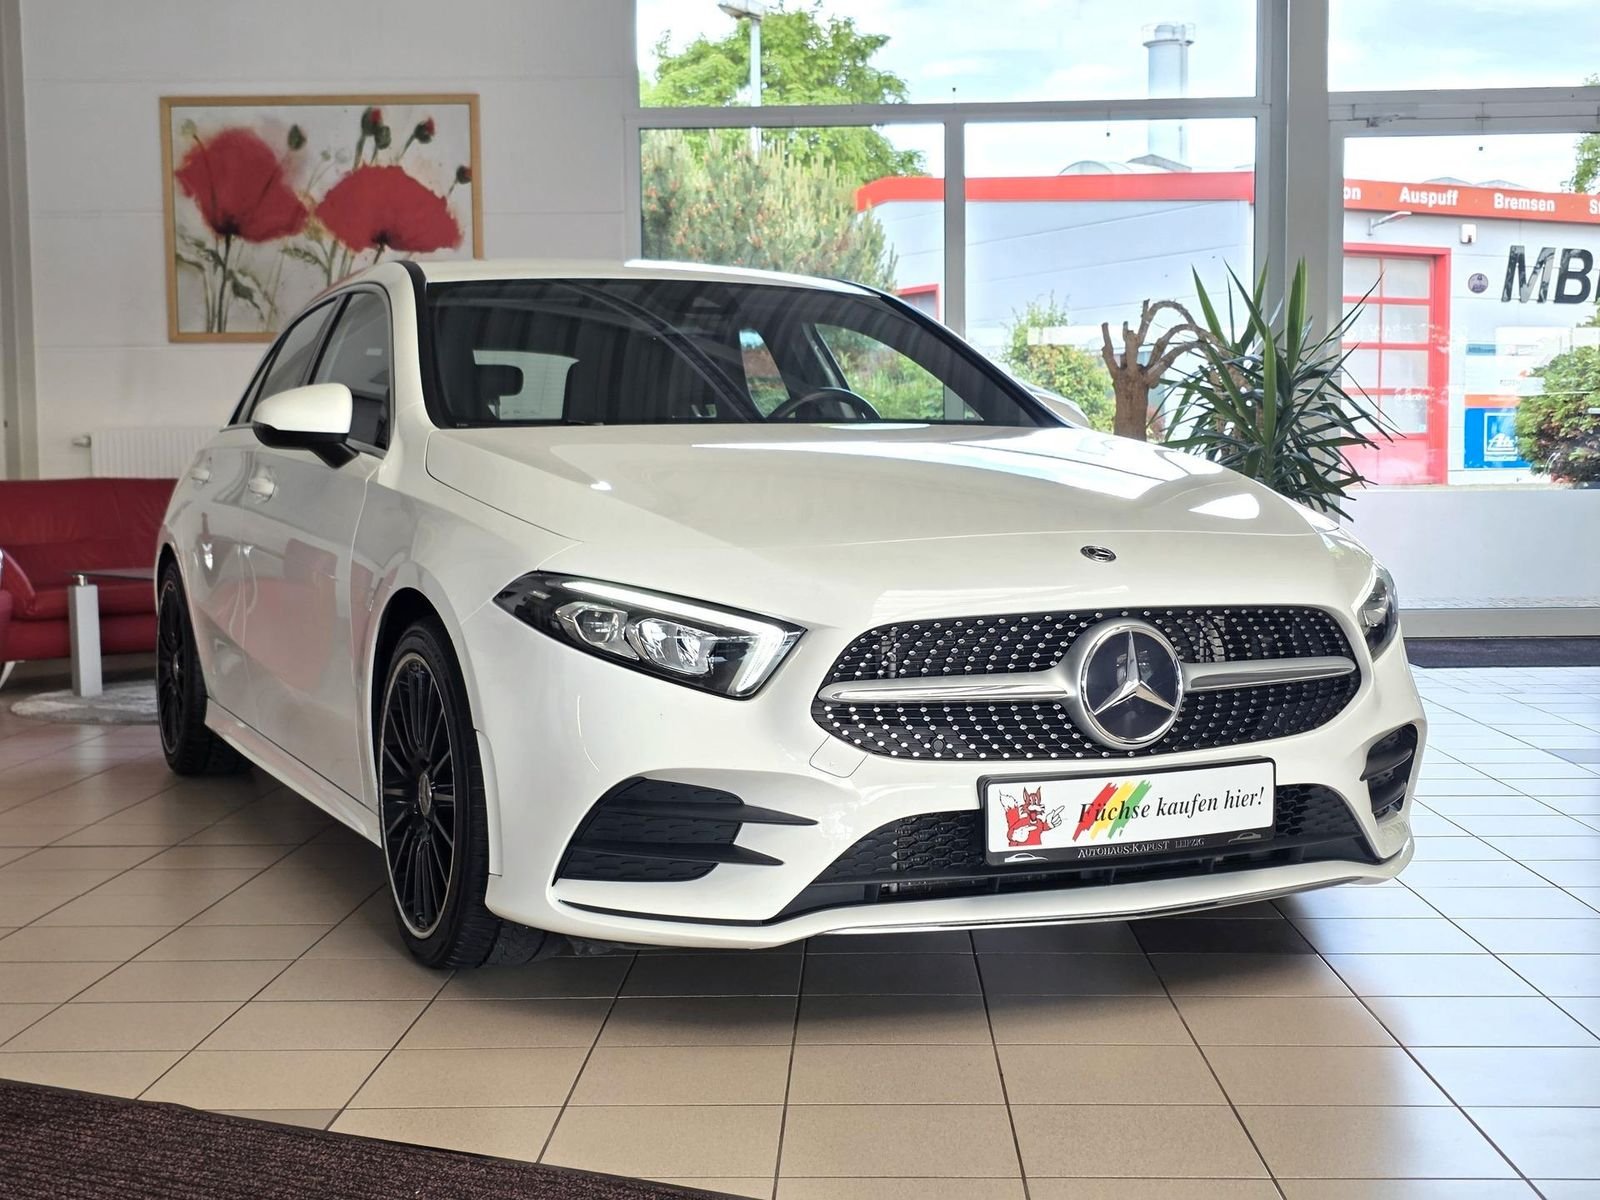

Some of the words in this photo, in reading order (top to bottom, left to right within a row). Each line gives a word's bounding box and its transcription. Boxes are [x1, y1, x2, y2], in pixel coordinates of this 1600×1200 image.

[1399, 186, 1459, 207] Auspuff
[1494, 193, 1555, 213] Bremsen
[1588, 199, 1600, 215] S
[1501, 245, 1600, 304] MB
[1079, 800, 1150, 823] Füchse
[1156, 793, 1218, 819] kaufen
[1224, 786, 1264, 809] hier!
[1175, 838, 1205, 849] LEIPZIG
